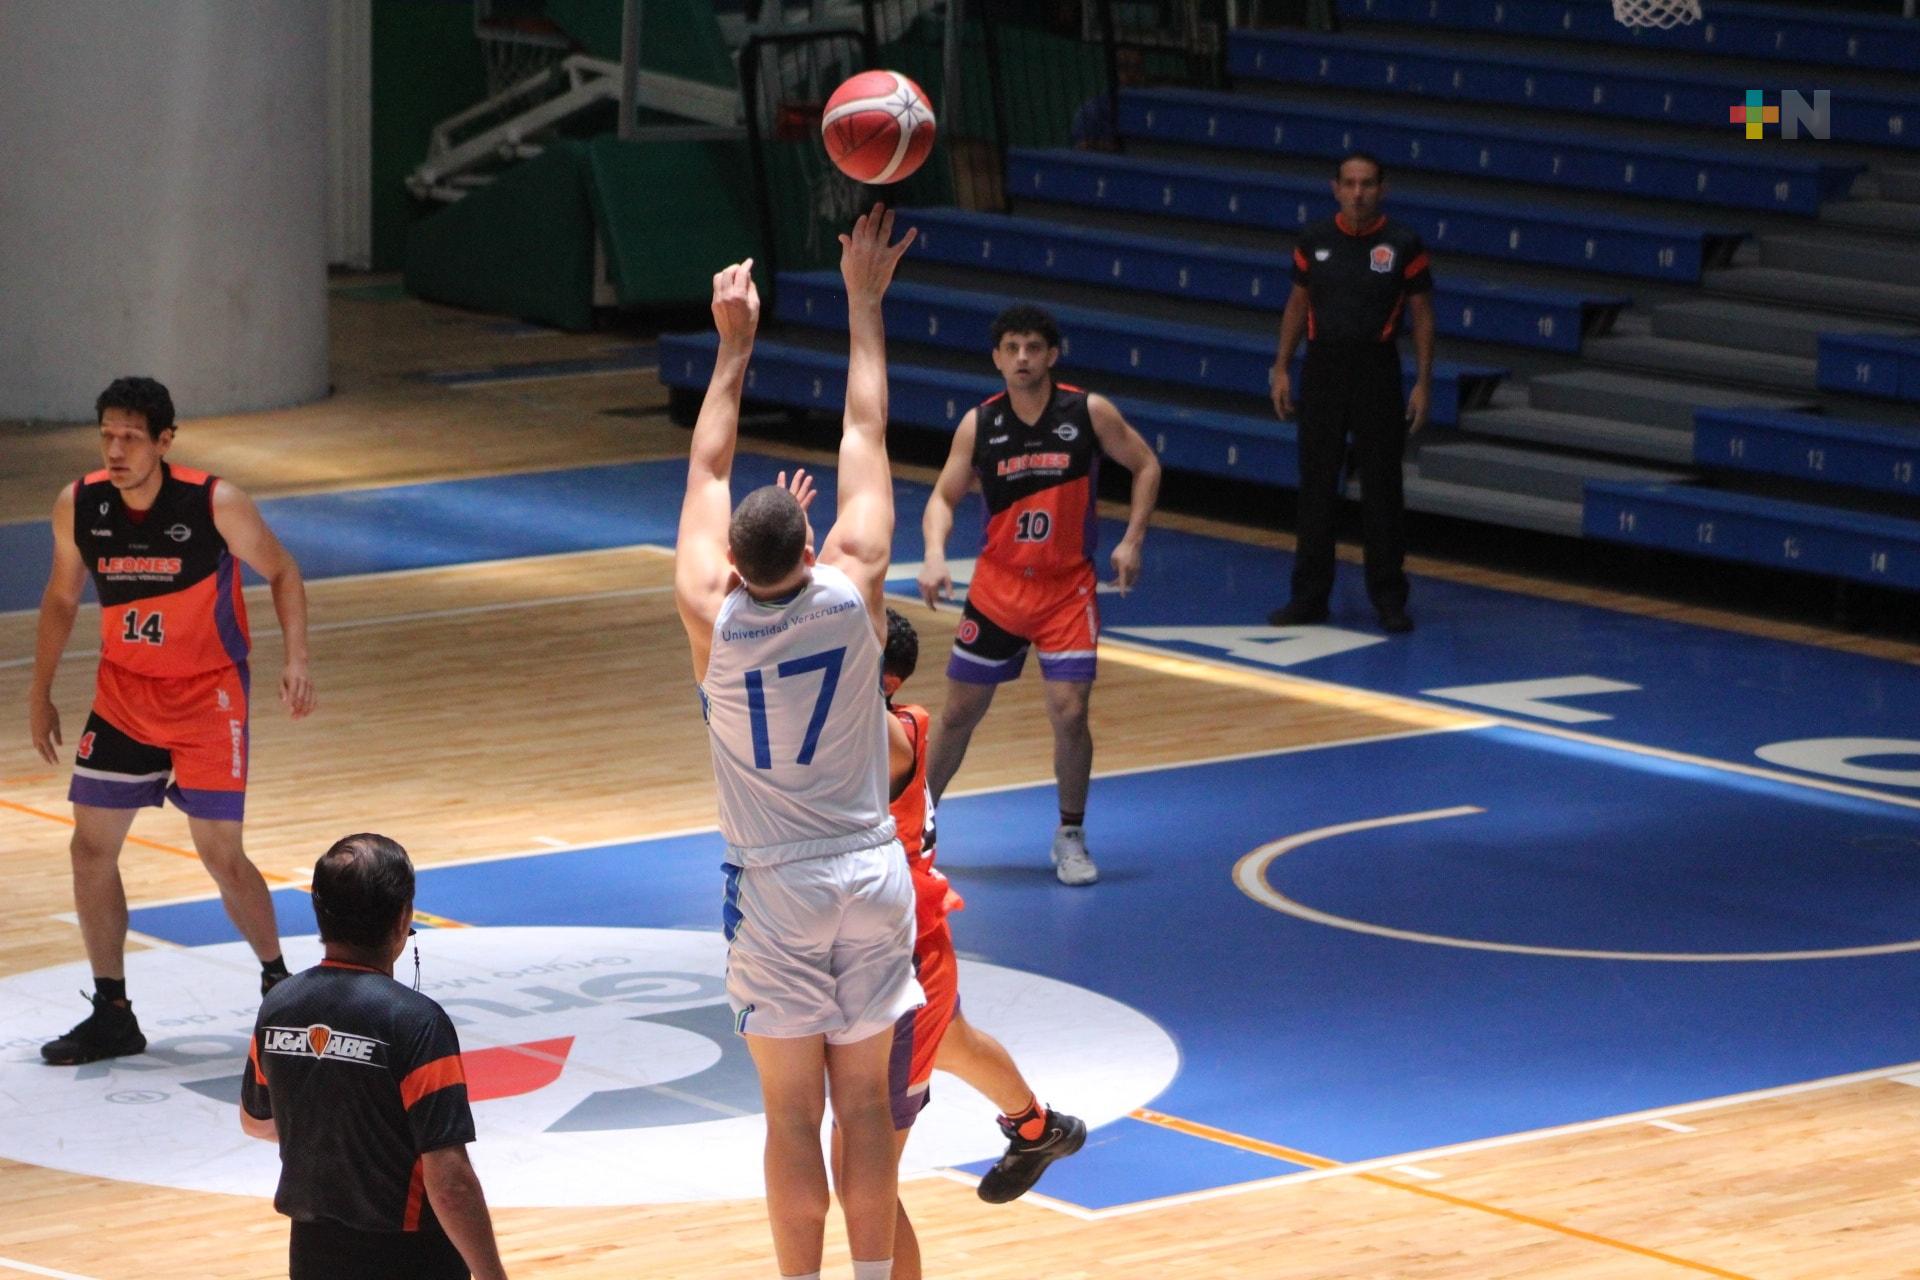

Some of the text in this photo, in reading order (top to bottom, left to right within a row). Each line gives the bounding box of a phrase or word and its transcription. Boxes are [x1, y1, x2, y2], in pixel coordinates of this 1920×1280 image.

[1657, 247, 1676, 268] 10
[1536, 316, 1556, 338] 10
[1855, 362, 1871, 383] 11
[1728, 437, 1745, 458] 11
[997, 452, 1070, 476] LEONES
[1807, 449, 1825, 472] 12
[1892, 461, 1913, 484] 13
[1015, 510, 1051, 543] 10
[1618, 510, 1637, 532] 11
[1696, 522, 1715, 544] 12
[98, 556, 182, 574] LEONES
[1869, 551, 1889, 574] 14
[122, 608, 164, 646] 14
[722, 599, 857, 642] Universidad Veracruzana
[743, 645, 848, 770] 17
[229, 719, 242, 779] LEONES
[494, 951, 632, 982] Grupo
[264, 1029, 376, 1061] LIGA ABE
